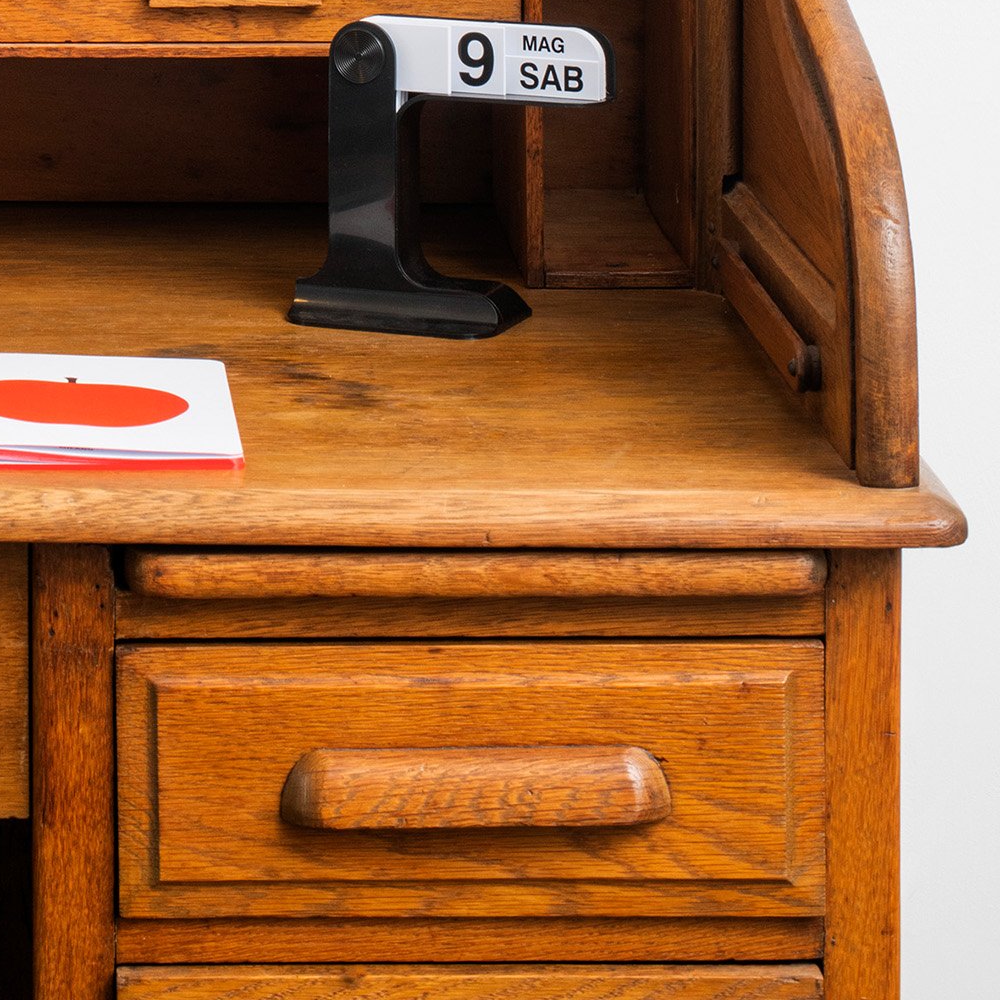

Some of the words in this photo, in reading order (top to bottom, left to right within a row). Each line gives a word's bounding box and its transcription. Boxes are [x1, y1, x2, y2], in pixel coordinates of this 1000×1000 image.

[457, 31, 495, 87] 9
[522, 34, 565, 54] MAG
[519, 62, 584, 93] SAB
